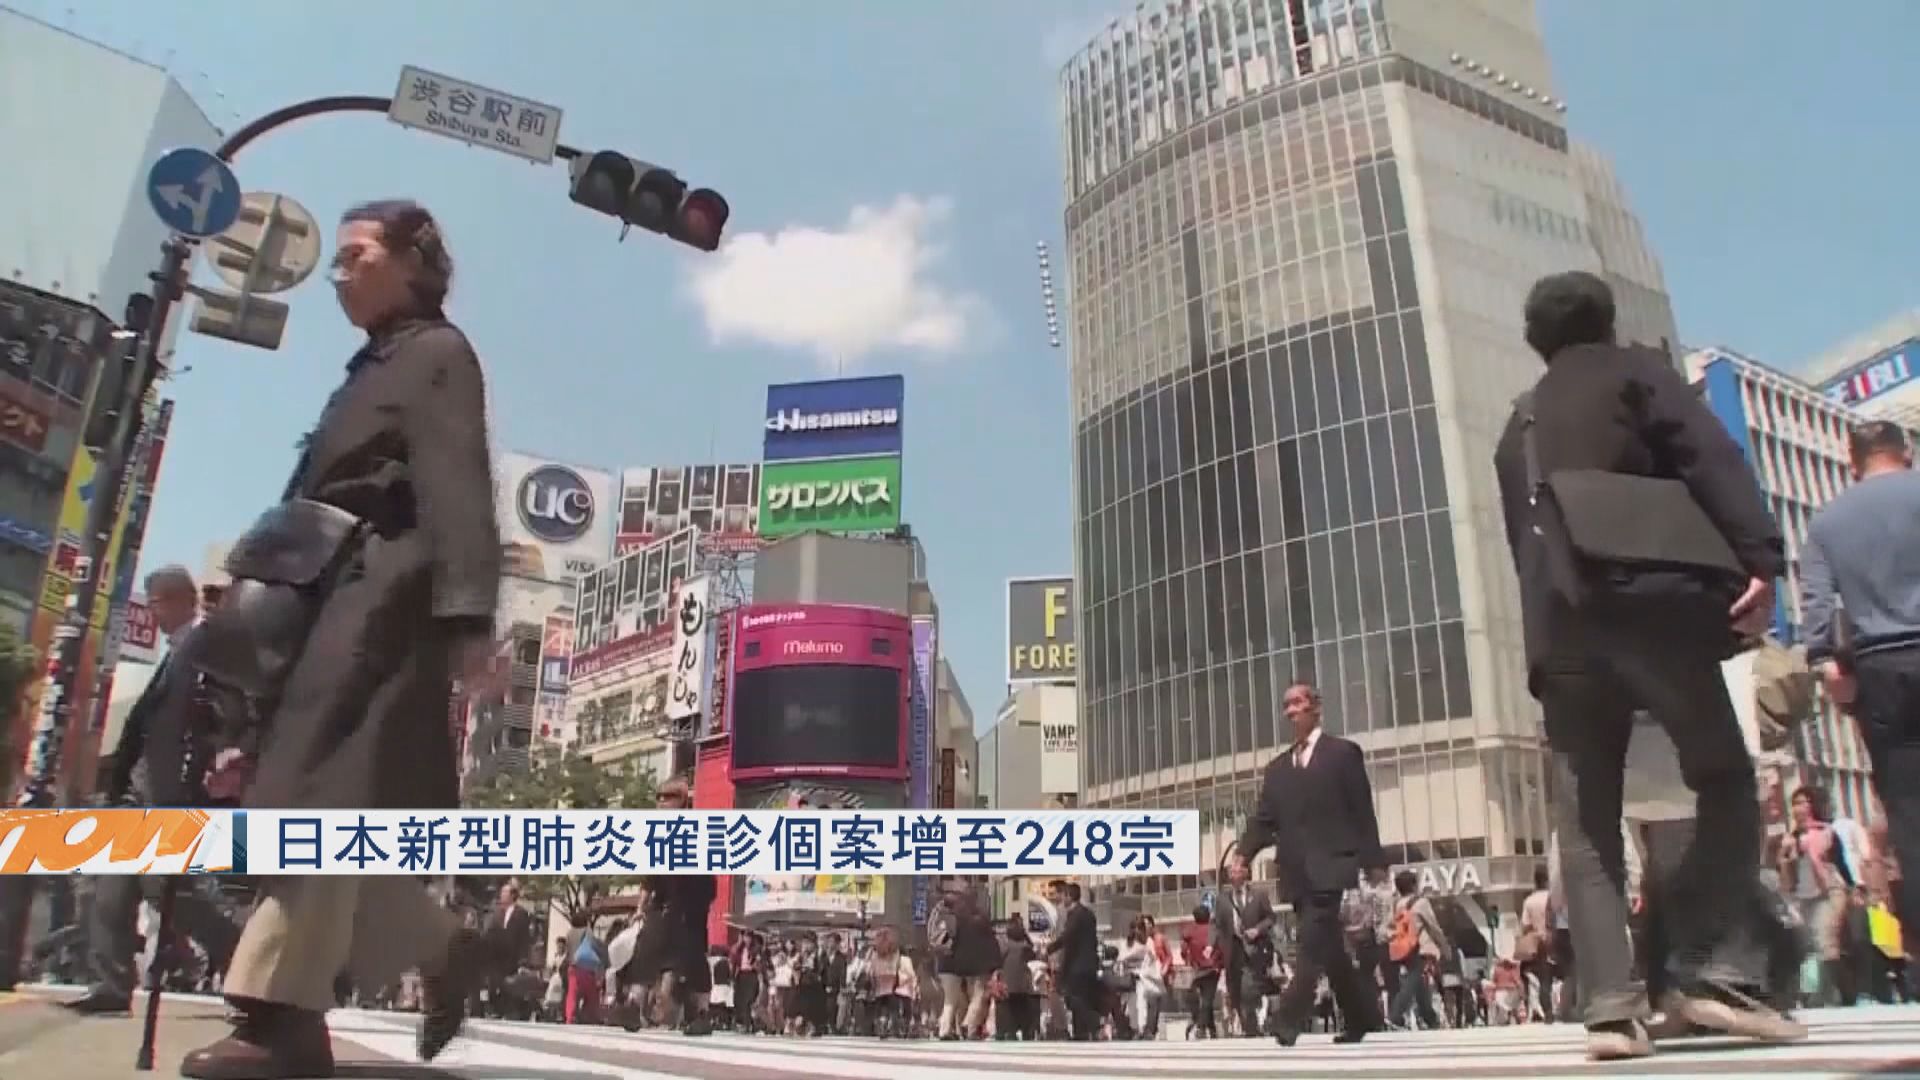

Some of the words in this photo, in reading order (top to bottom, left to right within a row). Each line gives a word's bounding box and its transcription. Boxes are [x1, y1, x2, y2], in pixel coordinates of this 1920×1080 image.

[409, 77, 548, 137] 渋谷駅前
[425, 110, 489, 140] Shibuya
[766, 408, 898, 432] Hisamitsu
[767, 476, 891, 510] サロンパス
[565, 560, 597, 575] VISA
[1045, 588, 1067, 638] F
[673, 591, 704, 710] もんじゃ
[1408, 863, 1481, 893] AYA
